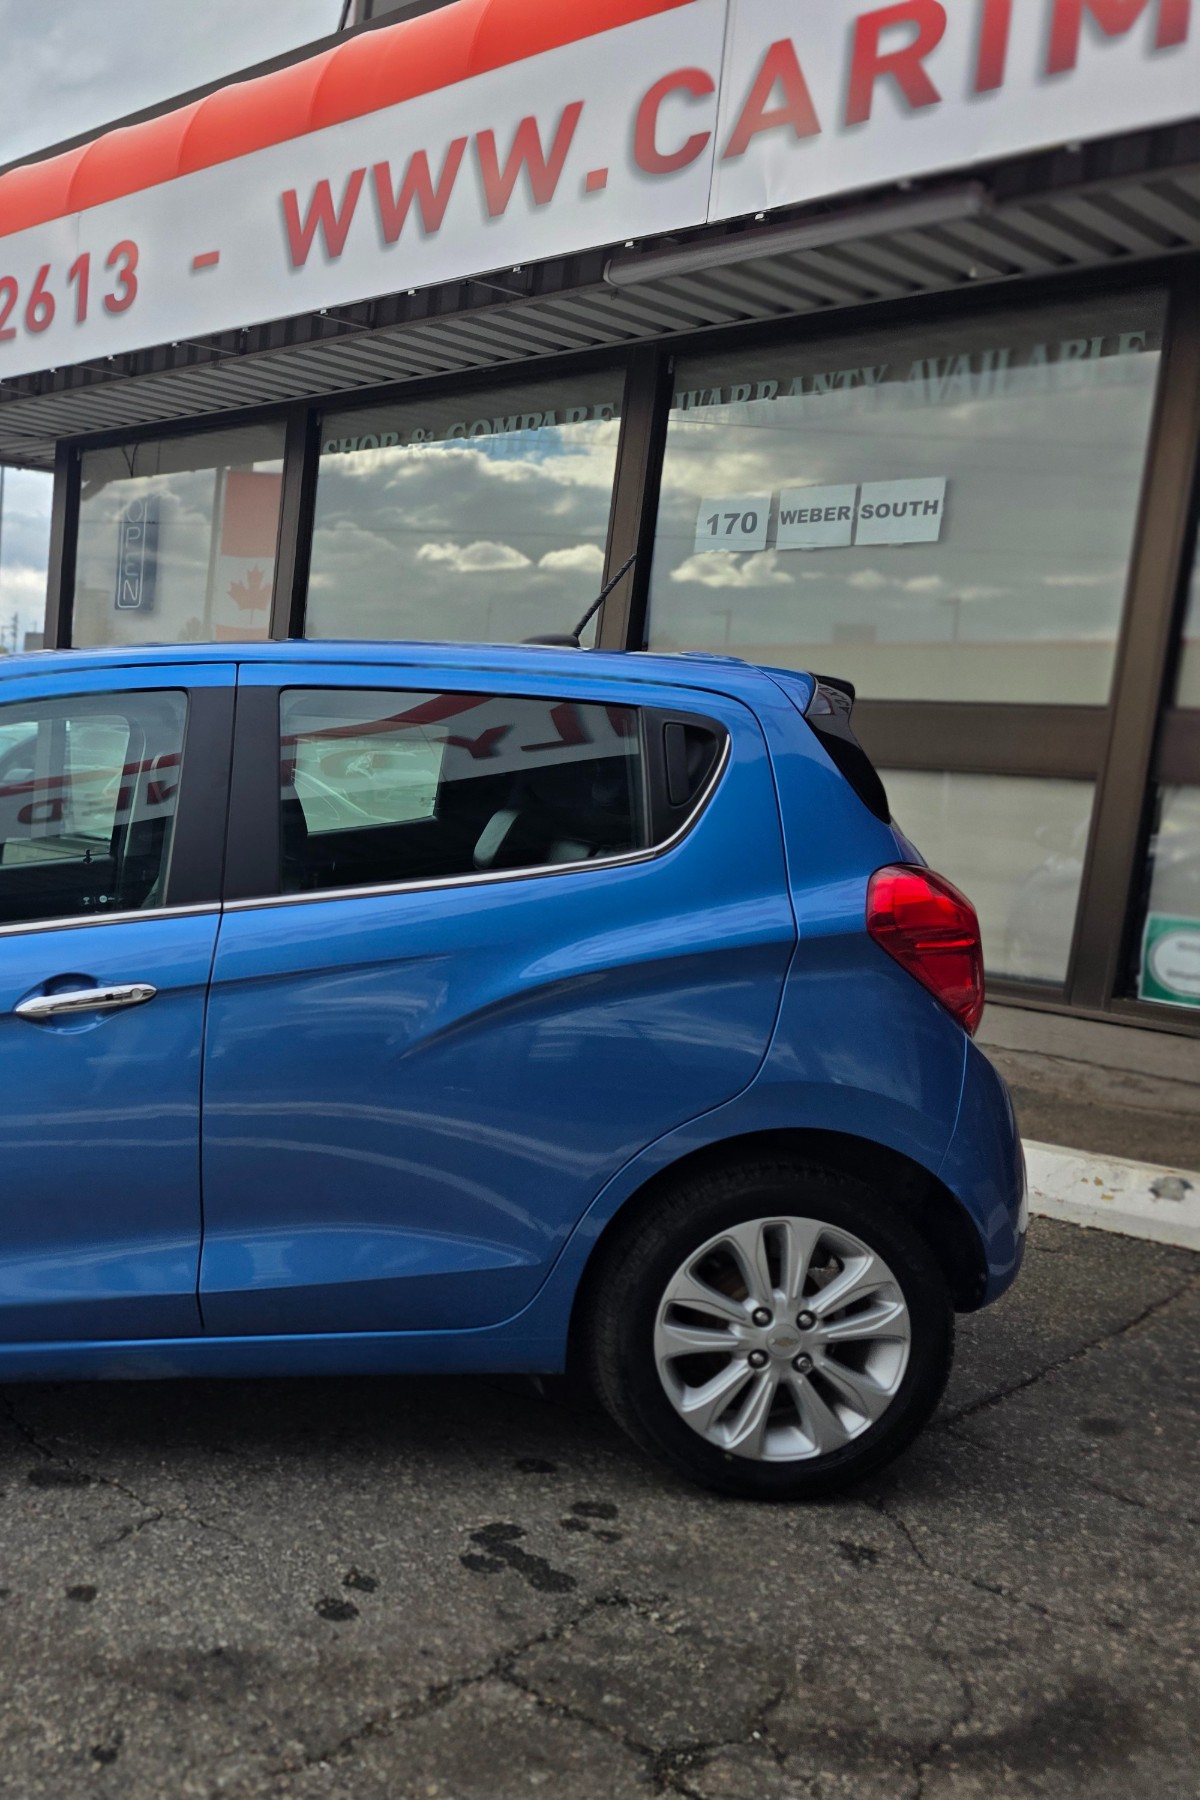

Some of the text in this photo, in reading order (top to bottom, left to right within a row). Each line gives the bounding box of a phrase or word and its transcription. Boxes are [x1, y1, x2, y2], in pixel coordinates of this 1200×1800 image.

[674, 330, 1147, 428] WARRANTY AVAILABLE
[446, 402, 617, 452] COMPARE
[123, 499, 144, 601] OPEN
[706, 499, 940, 536] 170 WEBER SOUTH
